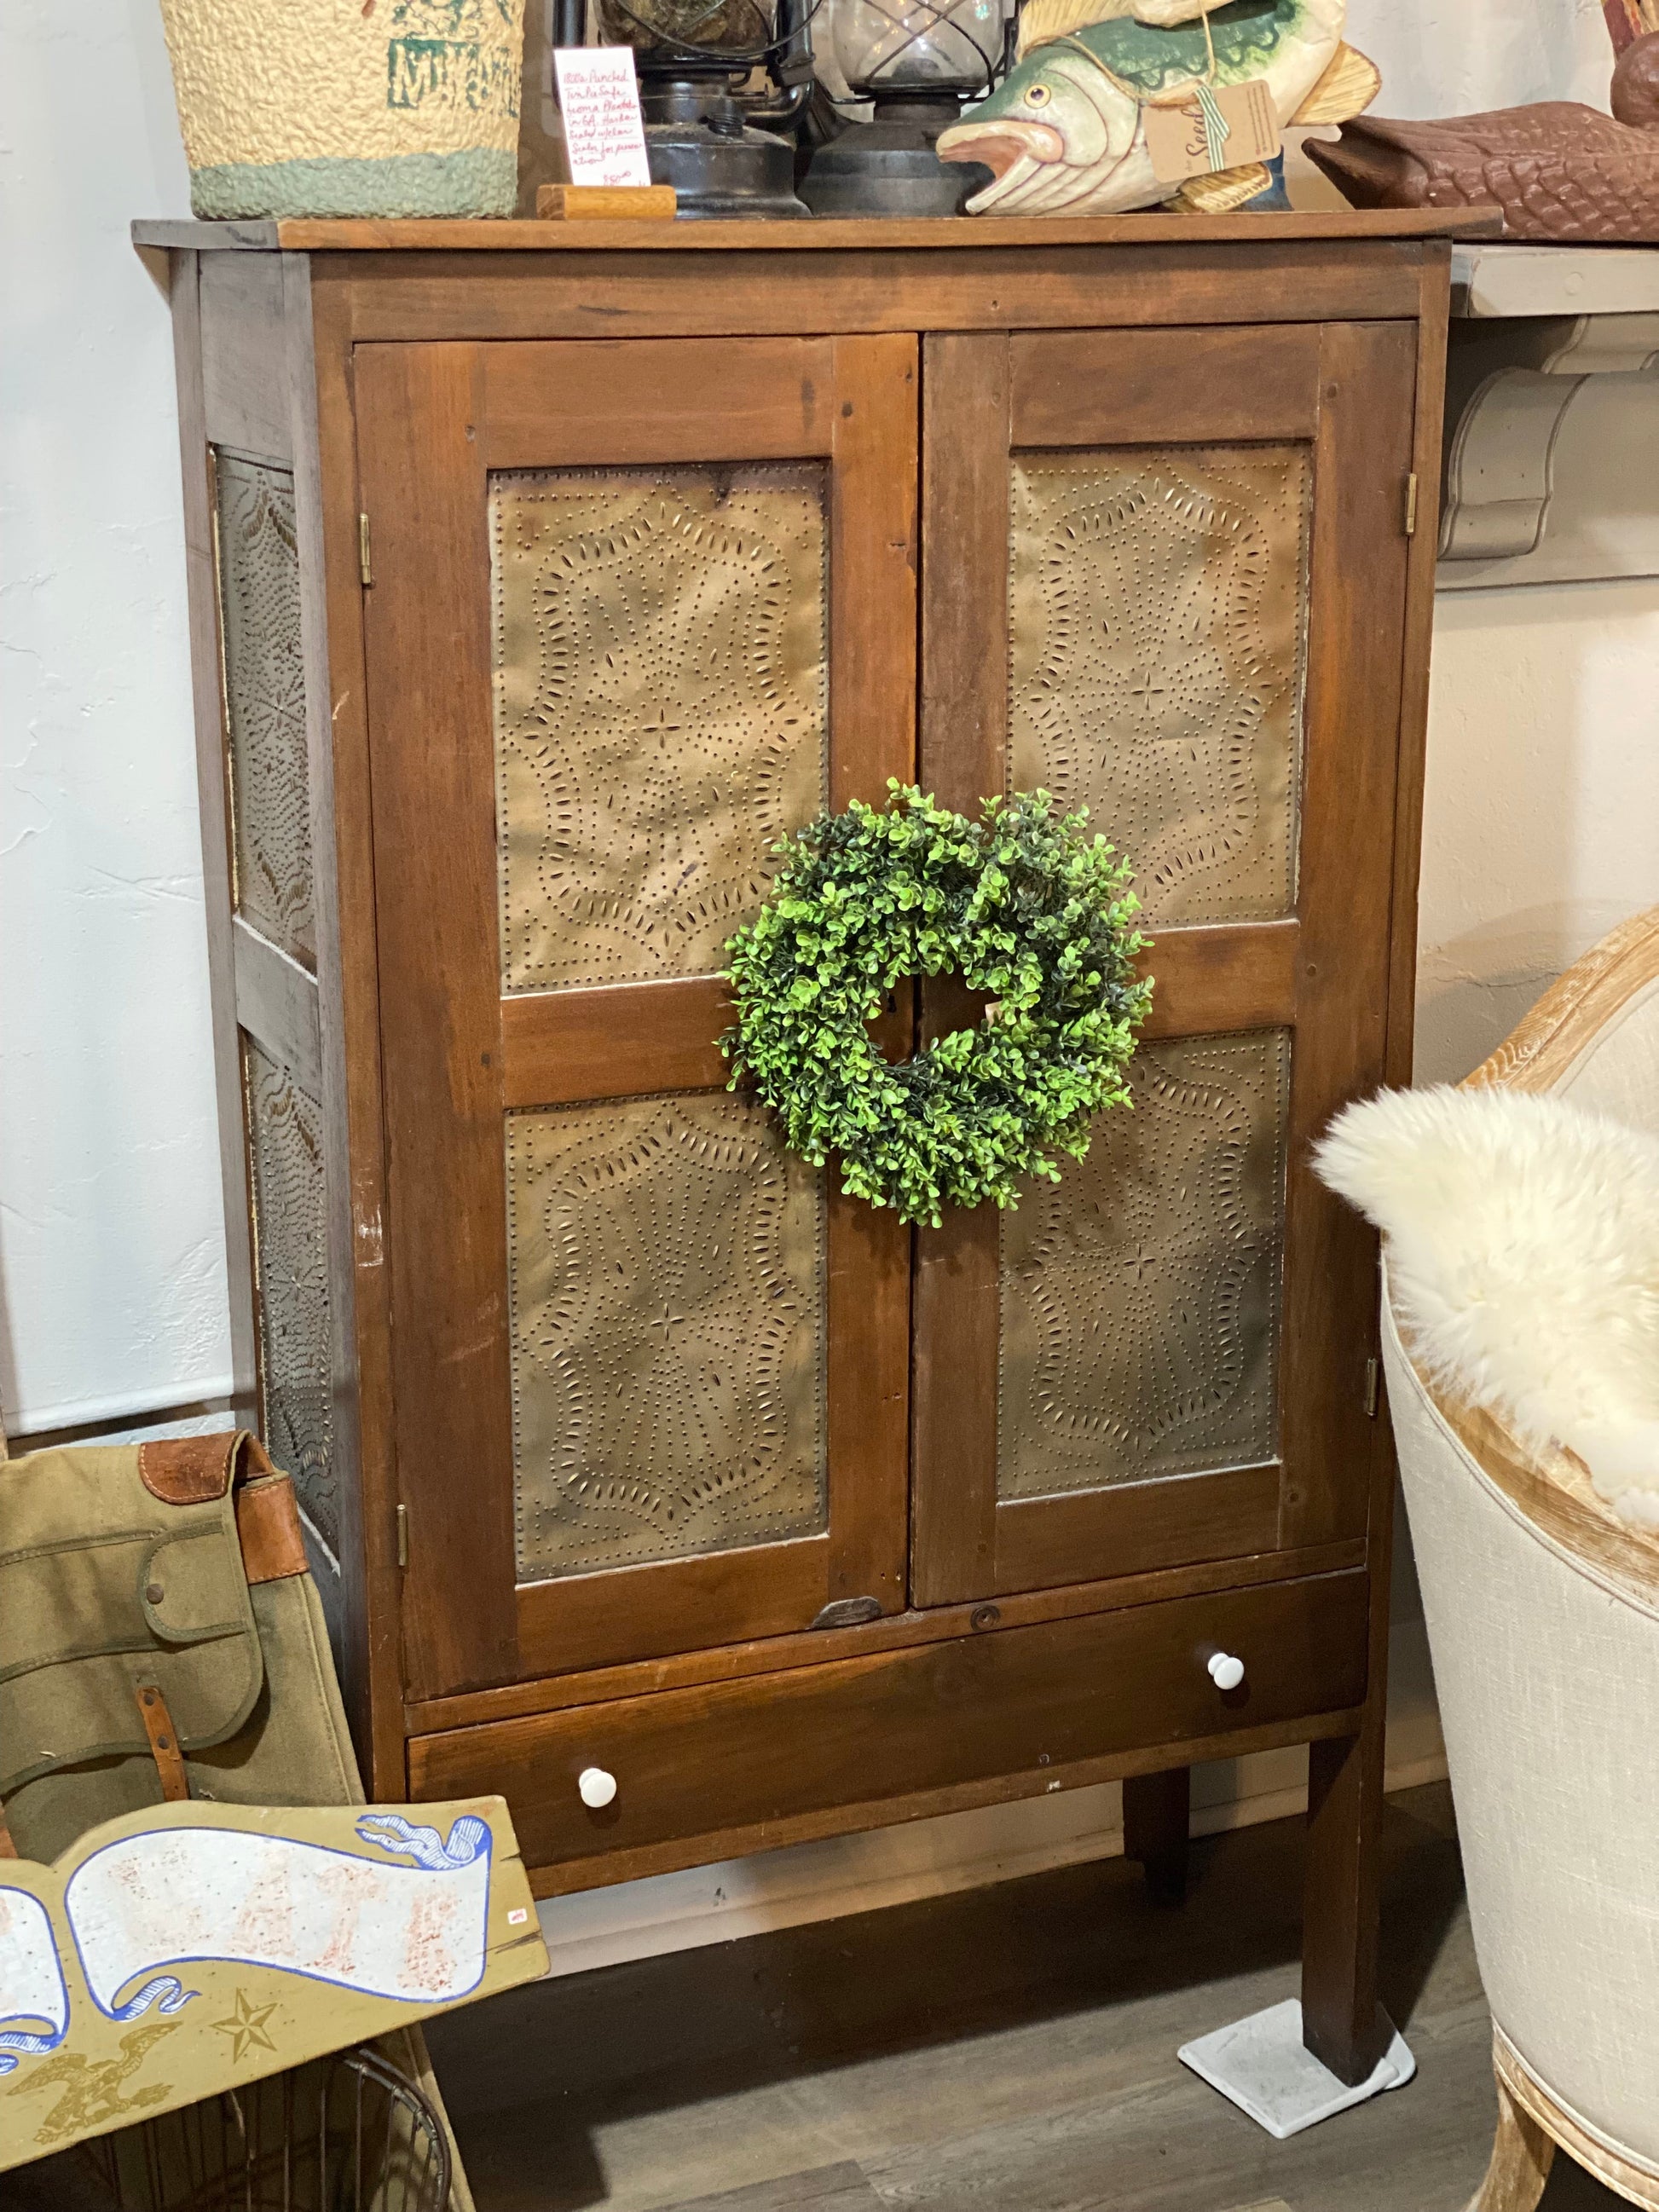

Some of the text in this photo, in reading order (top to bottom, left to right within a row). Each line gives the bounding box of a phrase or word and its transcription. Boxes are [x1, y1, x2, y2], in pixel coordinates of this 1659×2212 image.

[589, 68, 629, 83] Punched
[564, 84, 626, 100] Tin Pie Safe
[566, 101, 592, 118] from
[601, 141, 614, 159] for
